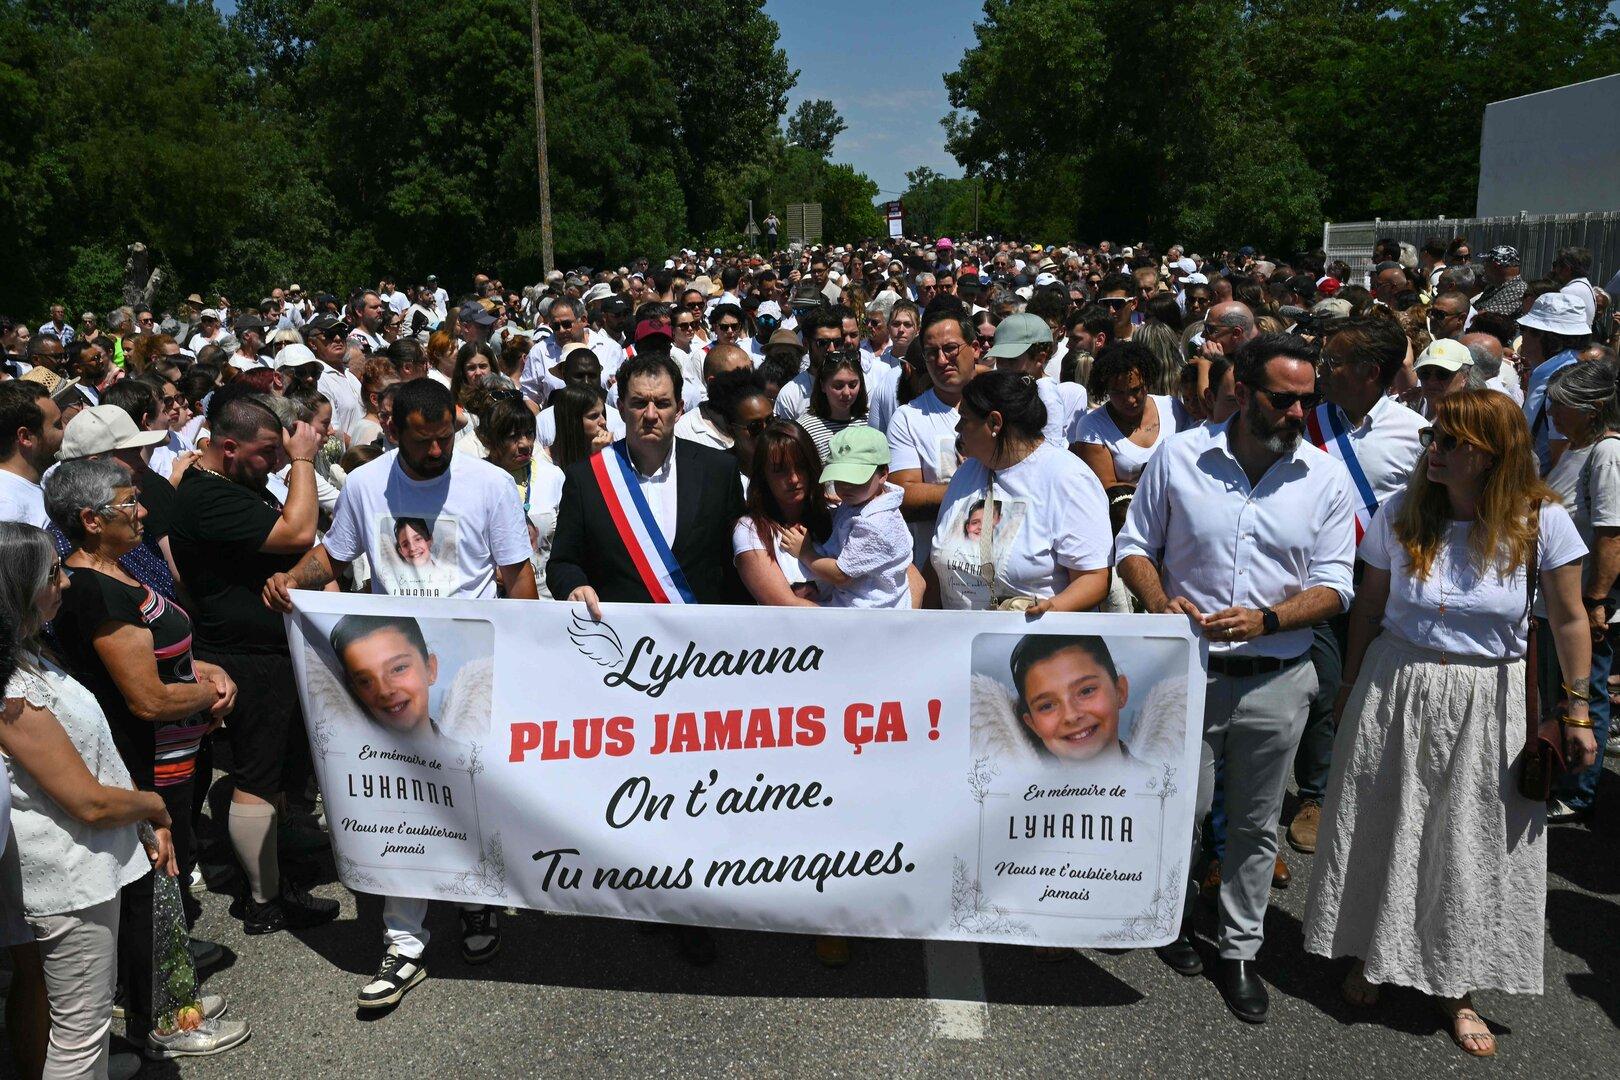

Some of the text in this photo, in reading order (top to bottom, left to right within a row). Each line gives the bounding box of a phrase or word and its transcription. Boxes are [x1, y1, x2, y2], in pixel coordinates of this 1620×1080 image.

[947, 559, 982, 576] LYHANN
[603, 635, 824, 698] Lyhanna
[509, 698, 941, 762] PLUS JAMAIS ÇA !
[359, 745, 442, 771] En mémoire de
[348, 774, 454, 808] LYHANNA
[605, 769, 833, 829] On t'aime.
[1024, 784, 1126, 801] En mémoire de
[341, 817, 467, 842] Nous ne t'oublierons
[1009, 813, 1133, 843] LYHANNA
[380, 841, 425, 857] jamais
[532, 842, 915, 893] Tu nous manques.
[995, 861, 1142, 881] Nous ne t'oublierons
[1039, 885, 1089, 902] jamais
